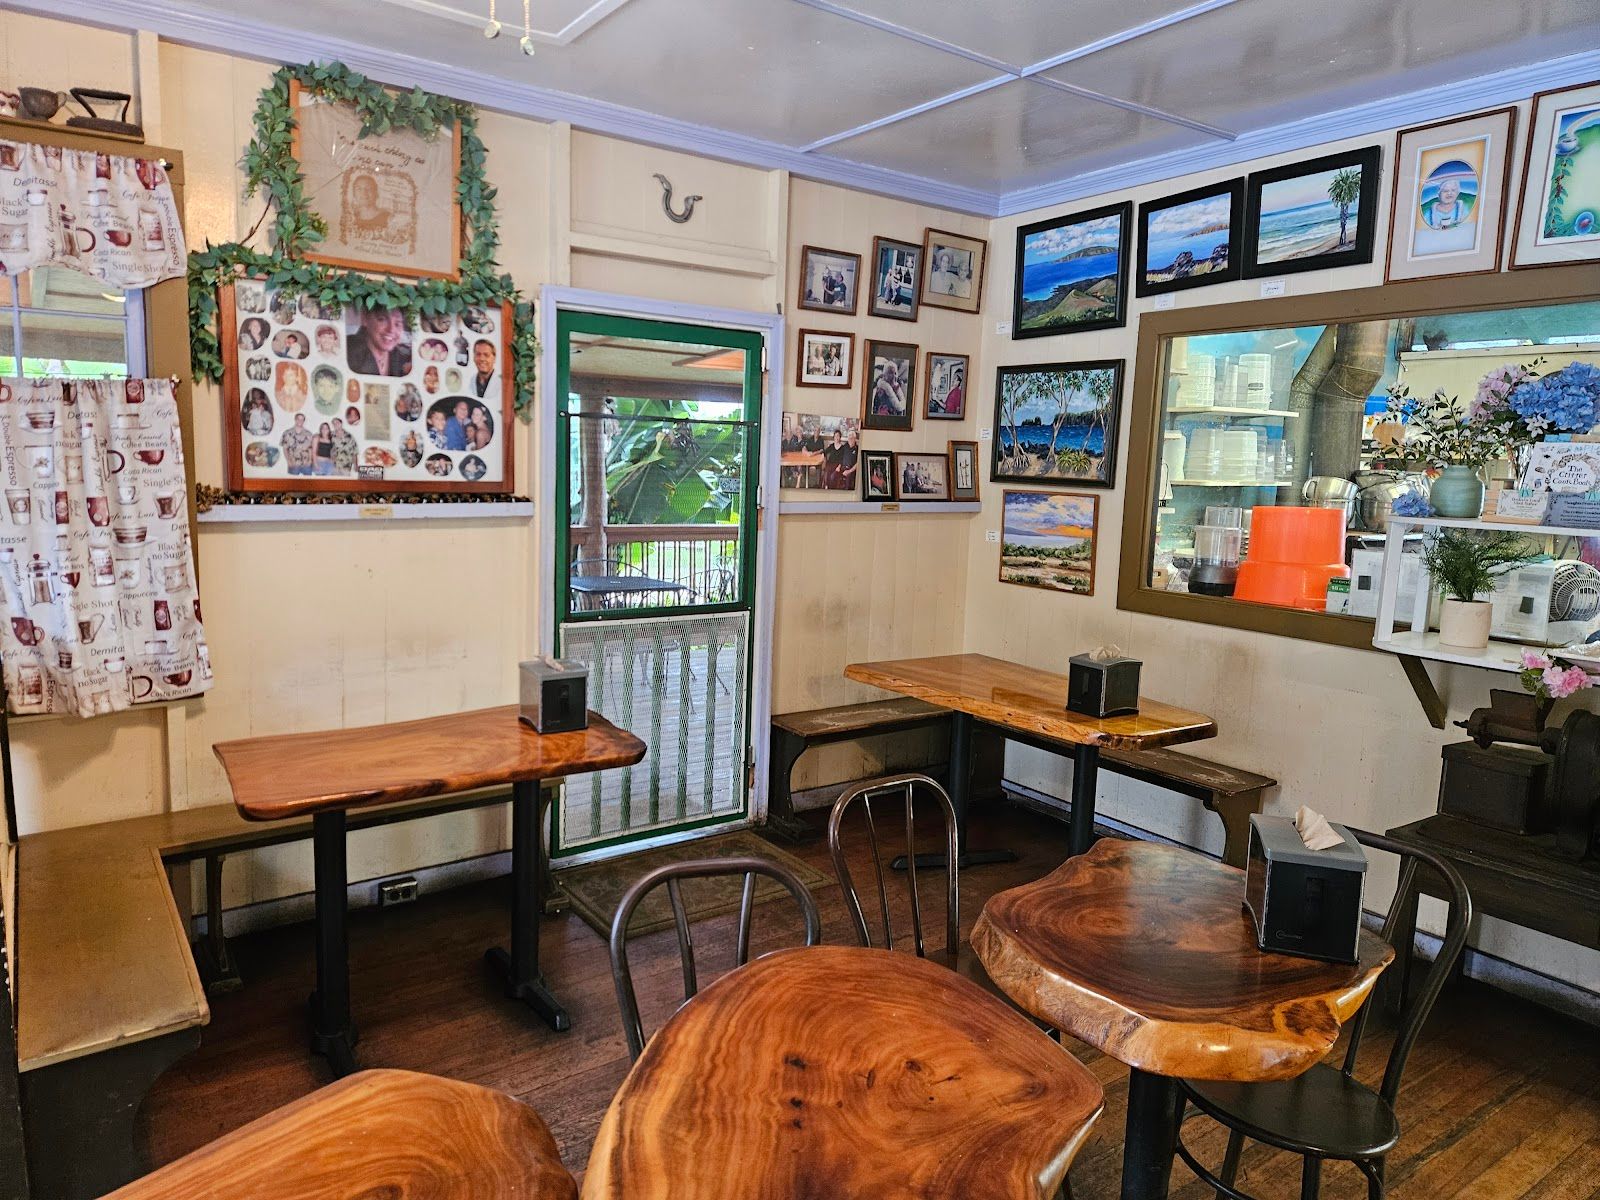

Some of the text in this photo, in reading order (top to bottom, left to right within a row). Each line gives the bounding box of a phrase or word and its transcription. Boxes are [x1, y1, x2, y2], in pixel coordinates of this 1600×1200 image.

[2, 206, 28, 217] Sugar
[168, 227, 180, 266] Espresso
[112, 263, 143, 273] Single
[5, 446, 17, 486] Espresso
[1567, 465, 1583, 473] The
[1558, 471, 1588, 479] Critter
[143, 477, 171, 488] Single
[163, 549, 187, 560] Sugar
[91, 599, 114, 609] Shot
